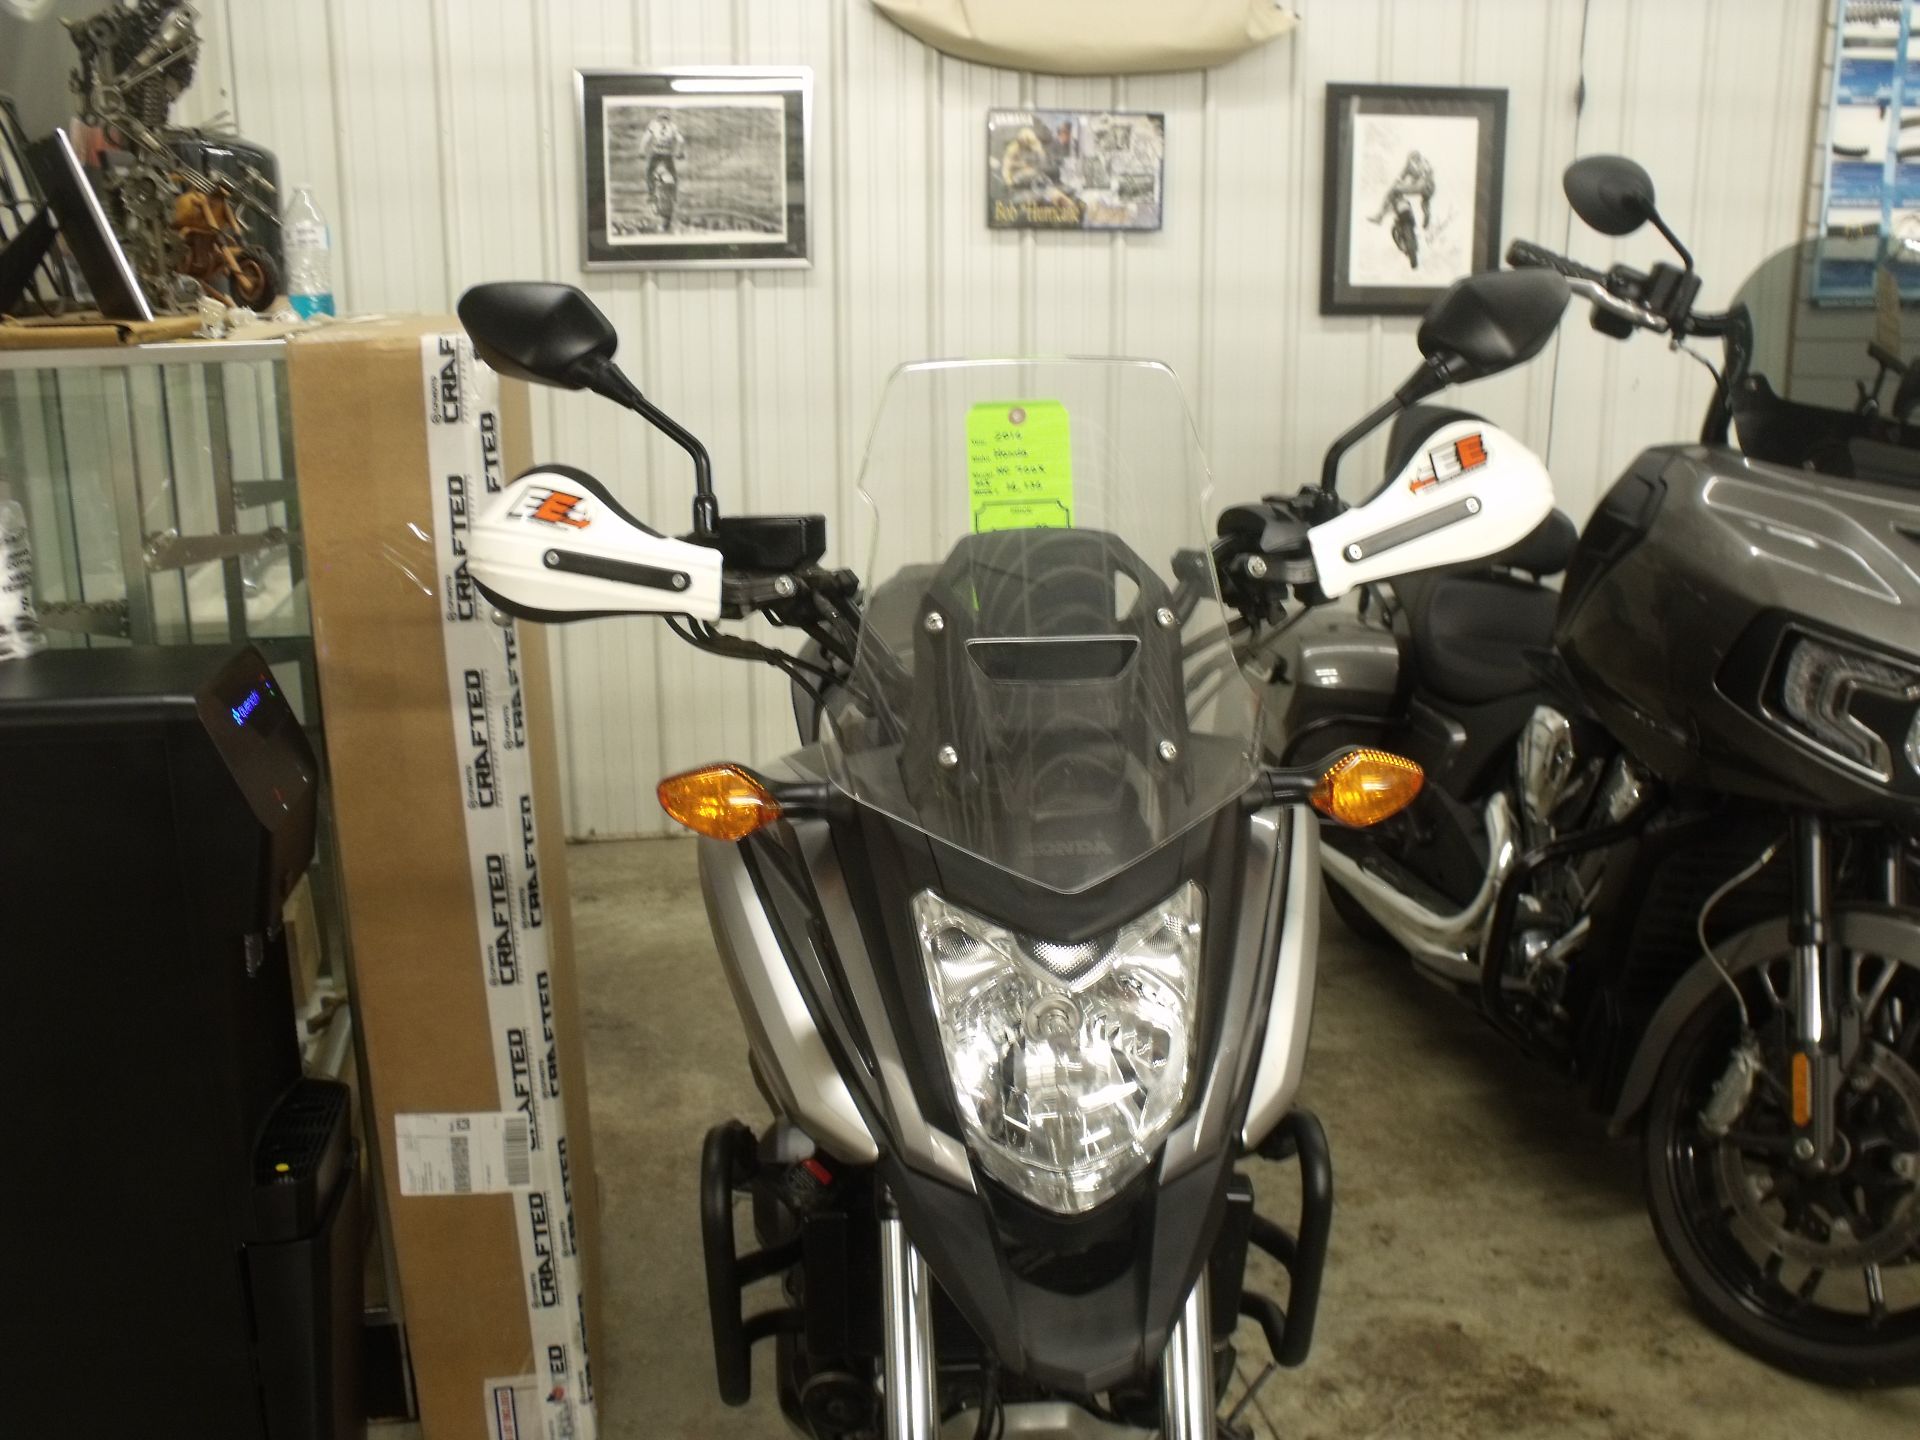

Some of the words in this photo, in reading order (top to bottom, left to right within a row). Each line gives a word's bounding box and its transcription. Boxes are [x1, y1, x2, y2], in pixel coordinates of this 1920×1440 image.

[447, 474, 475, 622] CRAFTED
[464, 669, 494, 809] CRAFTED
[503, 626, 525, 749] CRAFTE
[486, 854, 518, 987] CRAFTED
[520, 795, 542, 929] CRAFTED
[507, 1028, 537, 1151] AFTED
[536, 971, 560, 1098] CRAFTED
[529, 1192, 556, 1308] CRAFTED
